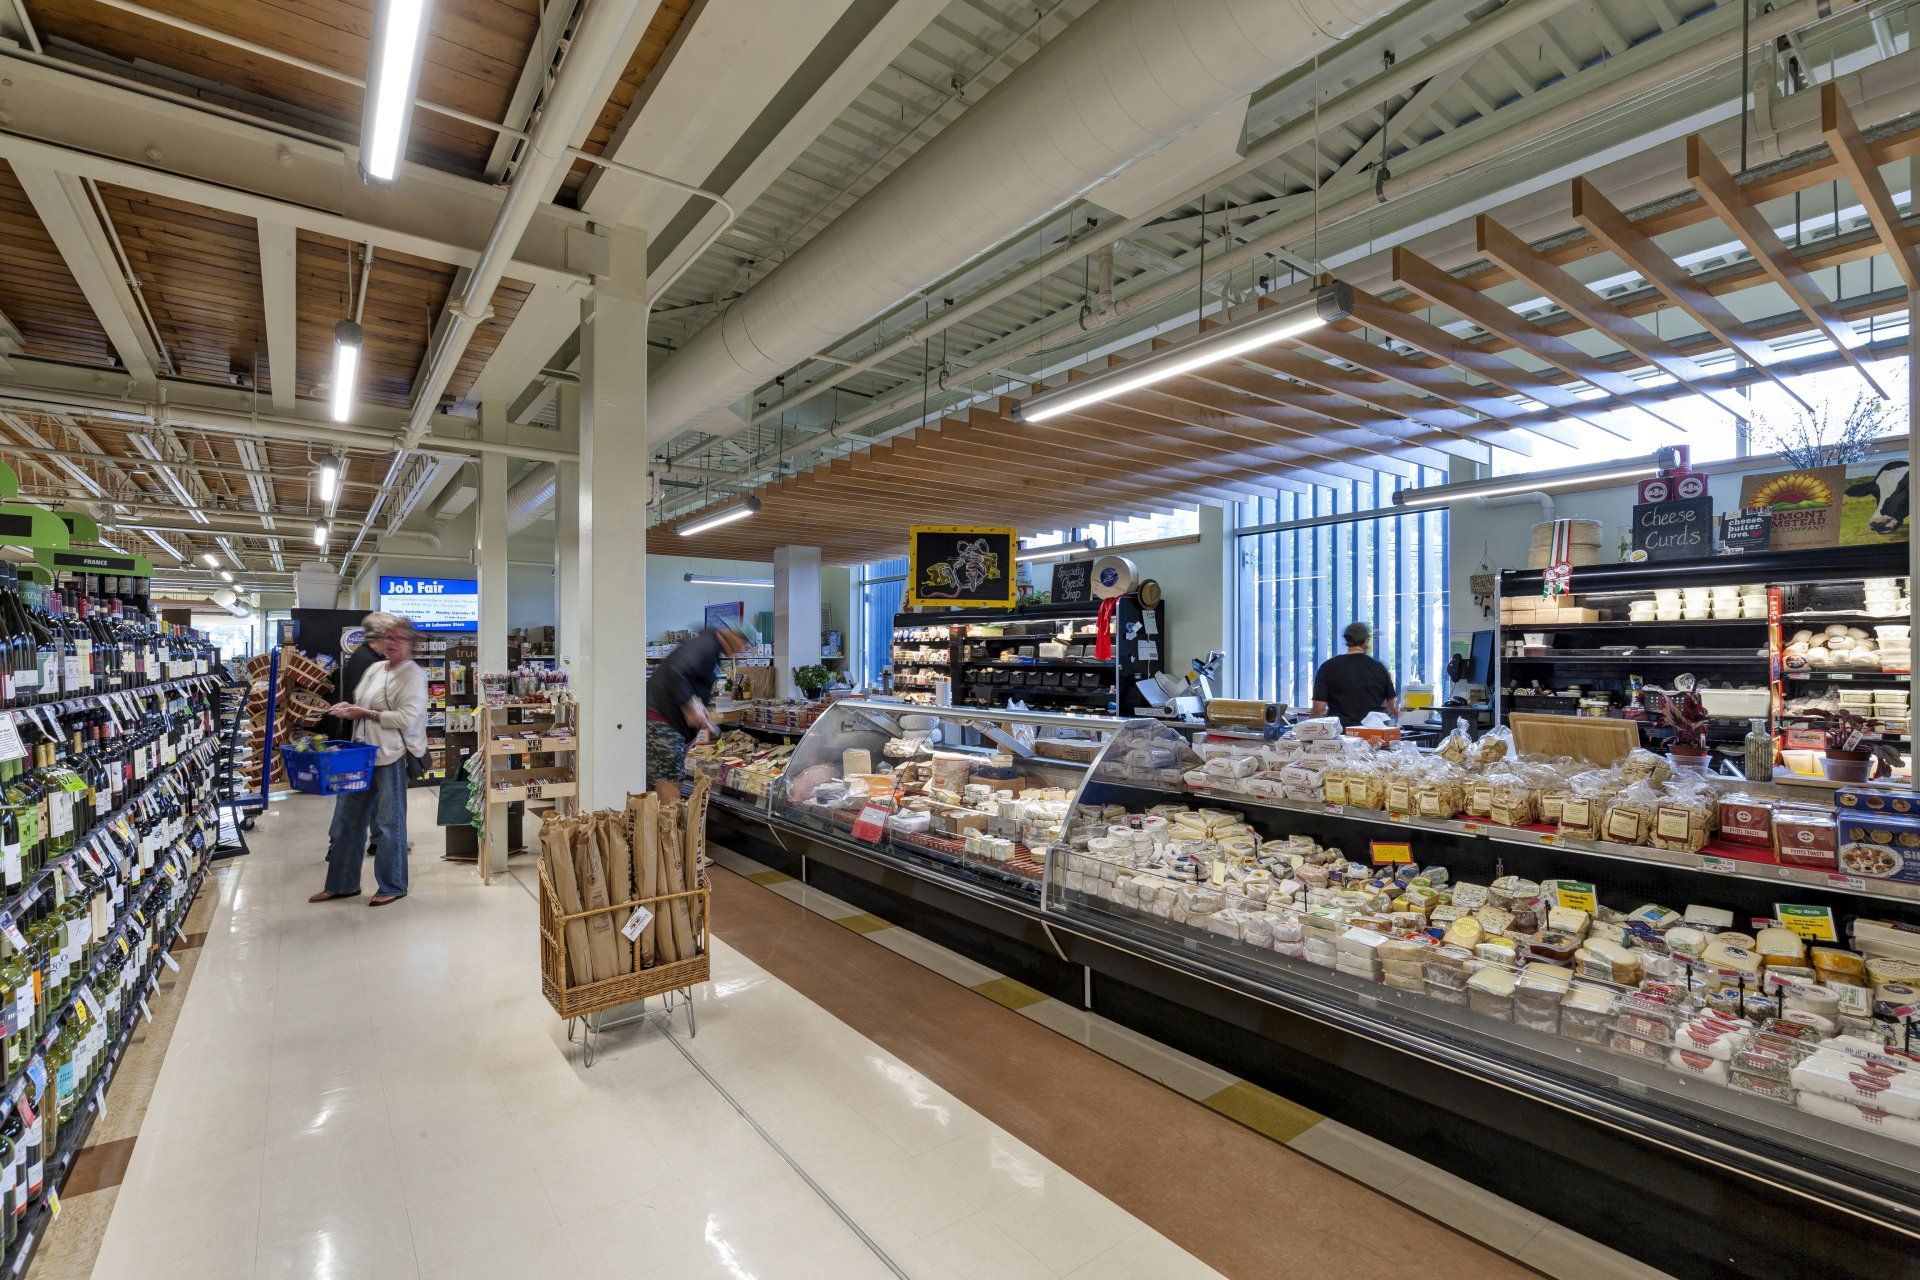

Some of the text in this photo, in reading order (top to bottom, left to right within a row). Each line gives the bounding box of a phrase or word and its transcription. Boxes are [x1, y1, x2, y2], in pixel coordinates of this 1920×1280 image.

[1641, 504, 1696, 527] Cheese
[1771, 510, 1826, 520] RMONT
[1728, 517, 1764, 526] cheese.
[1771, 519, 1826, 528] MSTEAD
[1728, 525, 1762, 533] butter.
[1781, 525, 1825, 533] COMPANY
[1645, 524, 1701, 549] Curds
[1727, 532, 1750, 540] love.
[83, 558, 108, 566] FRANCE
[1061, 578, 1085, 588] Cheese
[388, 581, 445, 595] Job Fair
[1062, 588, 1081, 602] Shop
